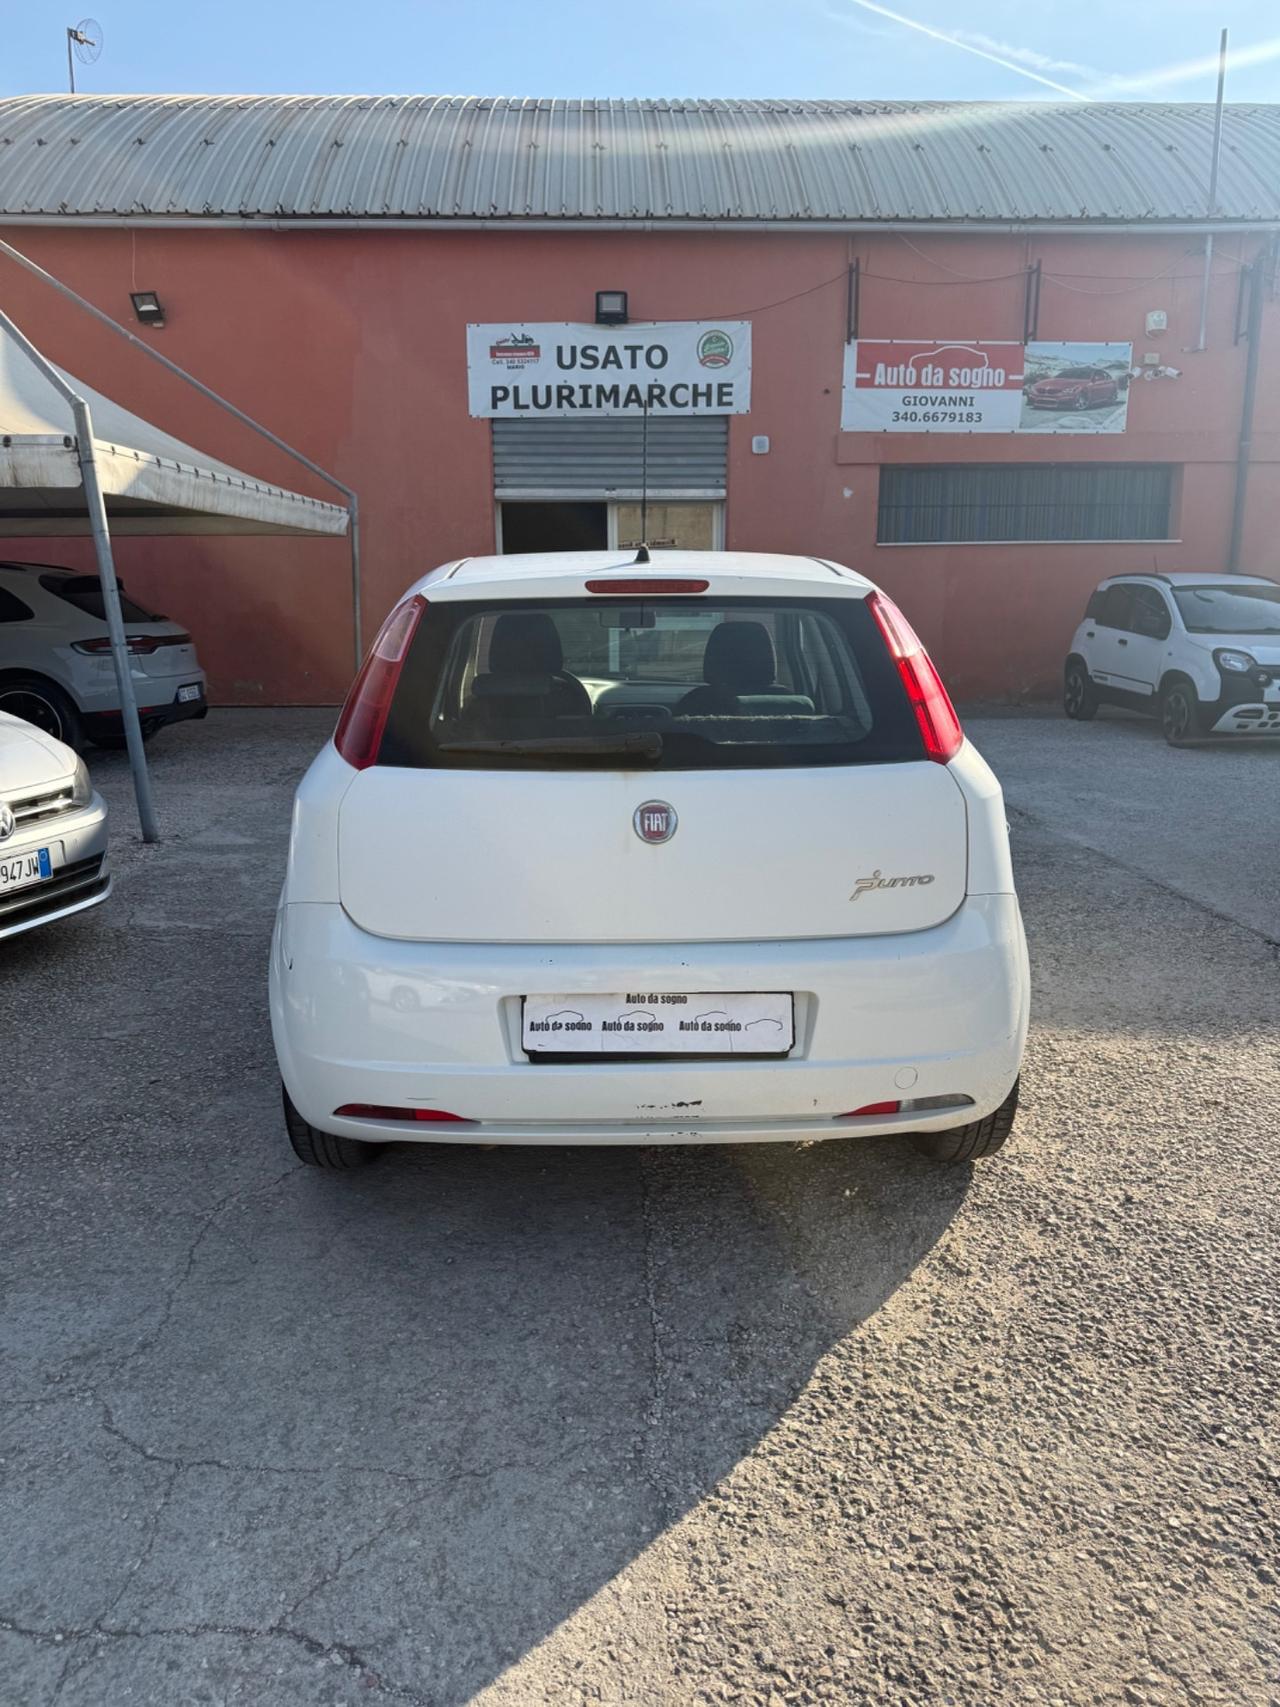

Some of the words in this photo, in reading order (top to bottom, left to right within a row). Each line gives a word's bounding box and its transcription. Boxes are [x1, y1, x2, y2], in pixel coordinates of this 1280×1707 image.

[556, 344, 668, 370] USATO
[874, 363, 917, 386] Auto
[921, 363, 943, 386] da
[949, 367, 1005, 388] sogno
[490, 382, 734, 410] PLURIMARCHE
[902, 395, 975, 407] GIOVANNI
[892, 411, 982, 423] 340.6679183
[644, 812, 669, 832] FIAT
[625, 993, 646, 1004] Auto
[647, 993, 659, 1004] da
[660, 994, 688, 1005] sogno
[529, 1021, 549, 1032] Auto
[551, 1021, 563, 1031] da
[601, 1021, 621, 1032] Auto
[623, 1021, 635, 1031] da
[636, 1021, 664, 1032] sogno
[679, 1021, 699, 1032] Auto
[701, 1021, 712, 1031] da
